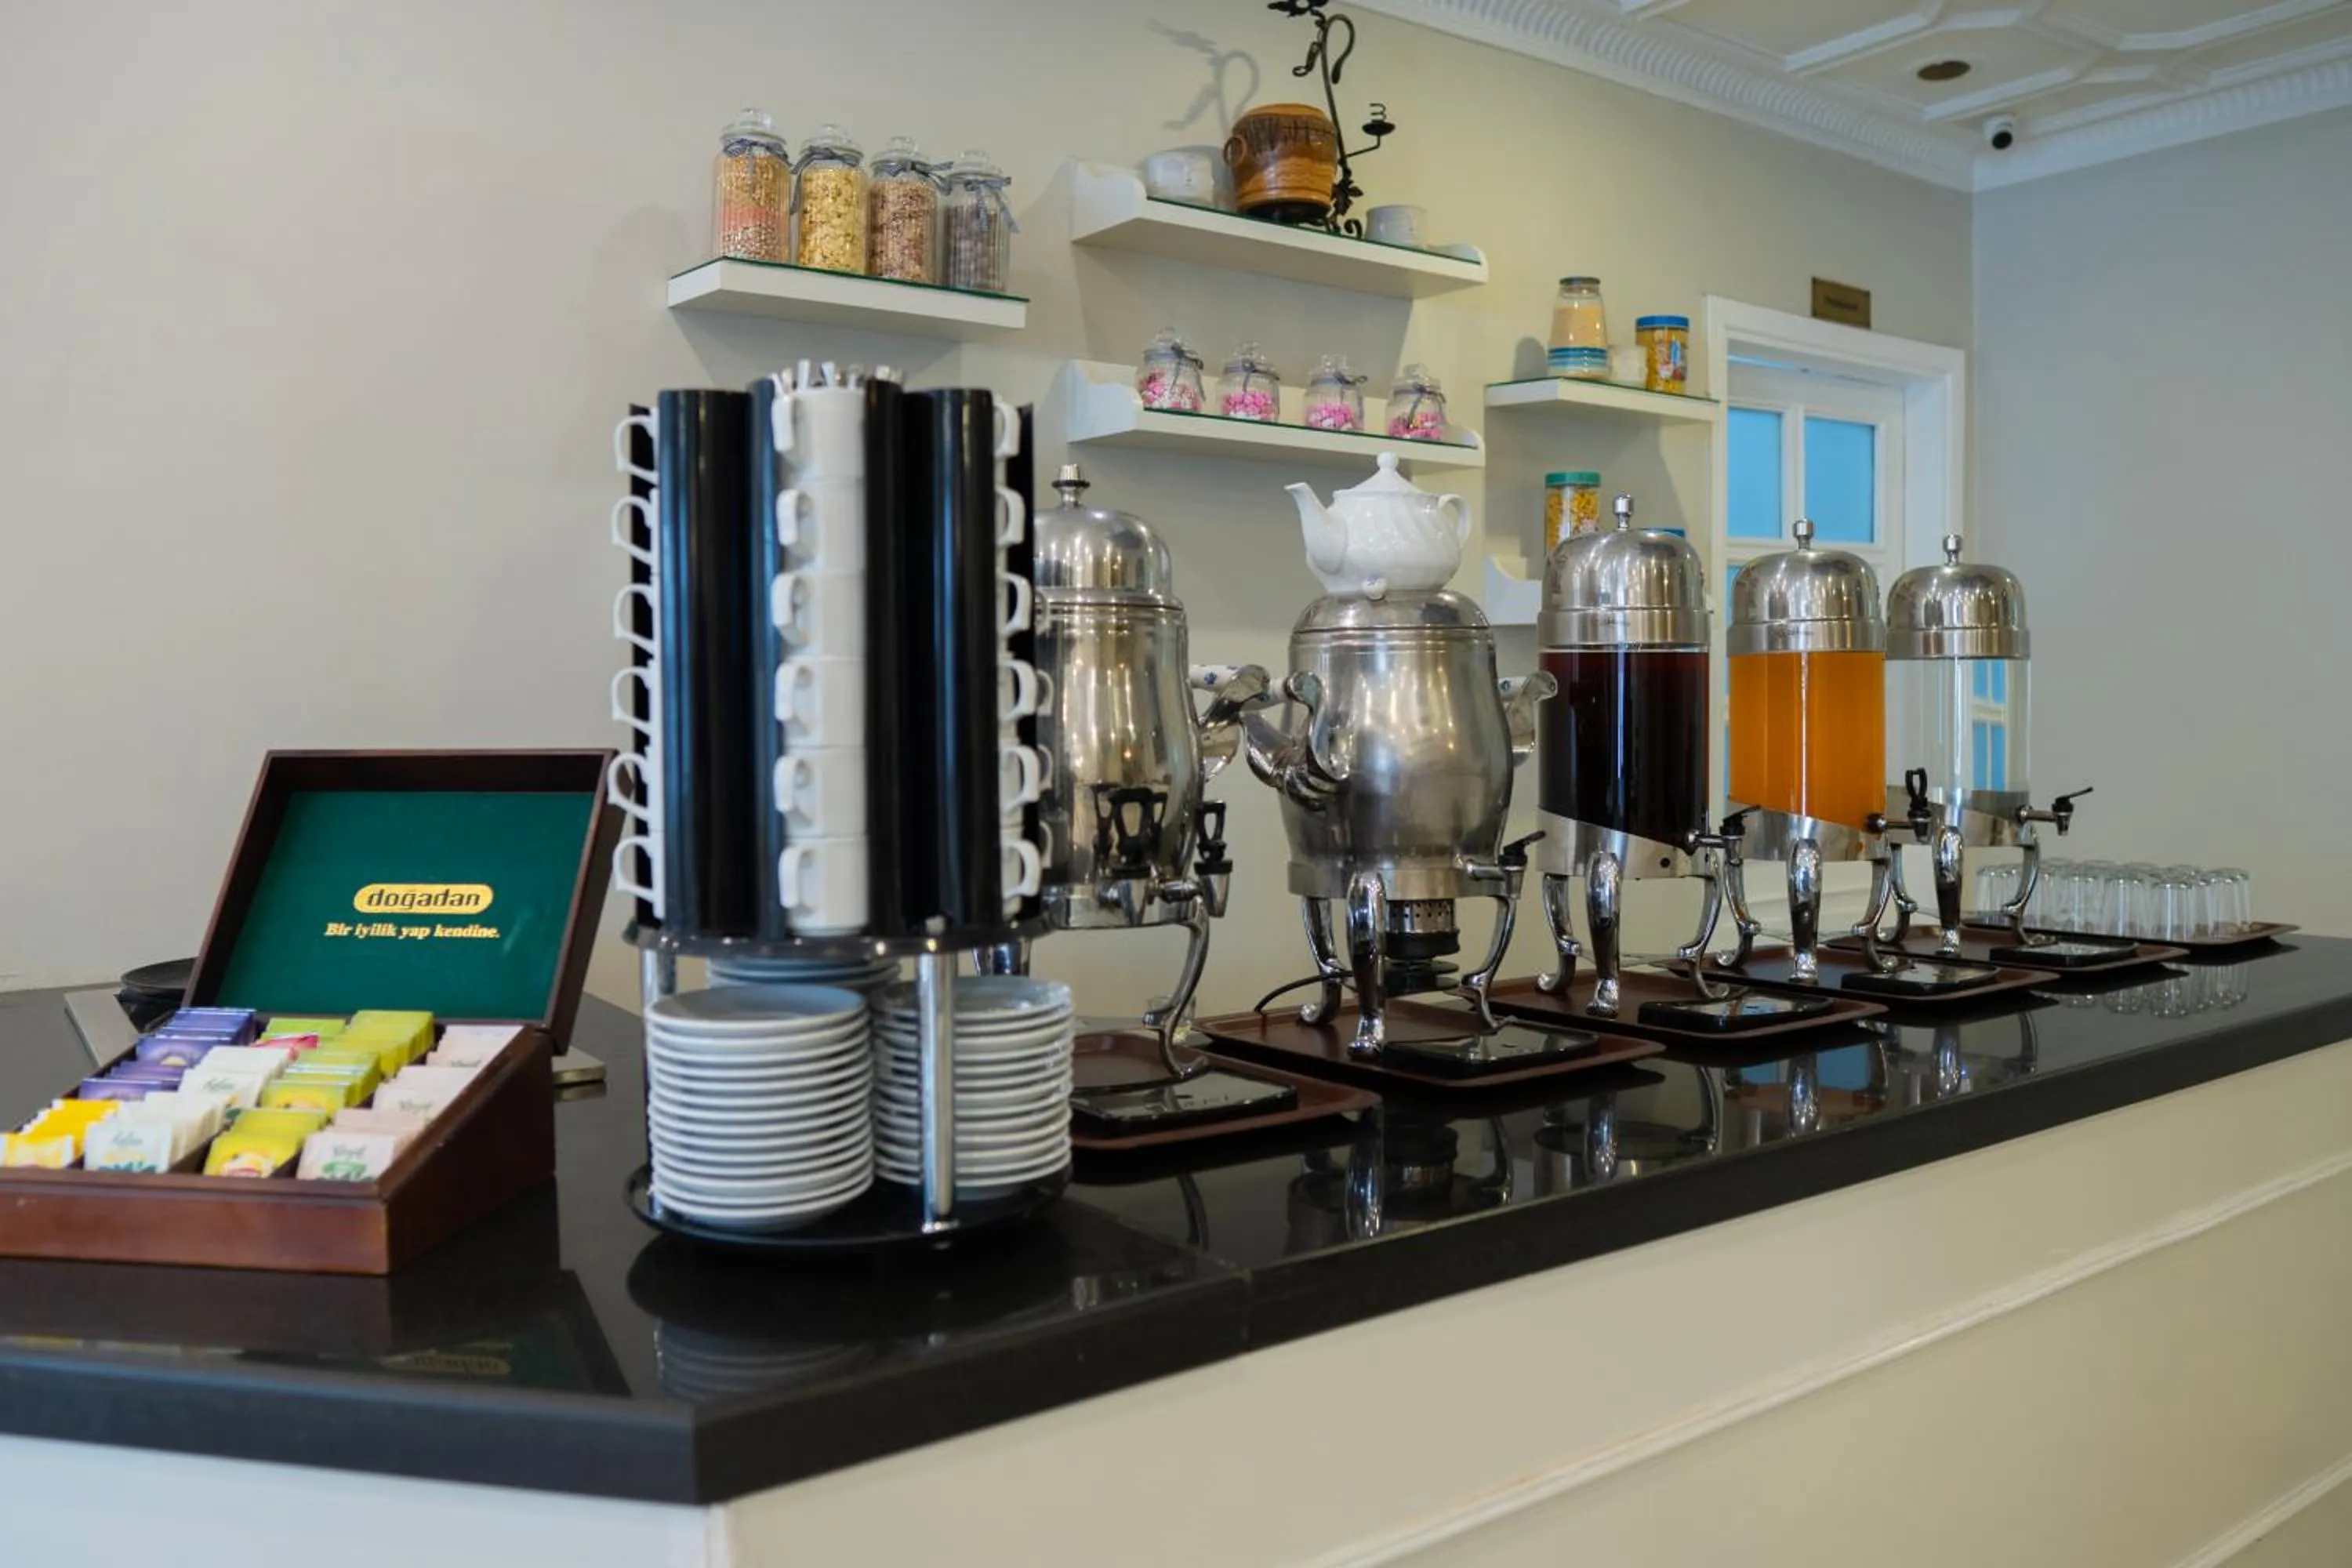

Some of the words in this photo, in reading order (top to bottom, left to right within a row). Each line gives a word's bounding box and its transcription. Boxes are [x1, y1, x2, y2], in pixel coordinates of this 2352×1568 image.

[324, 923, 352, 937] Bir
[354, 923, 397, 939] iyilik
[398, 926, 431, 940] yap
[434, 924, 501, 938] kendine.
